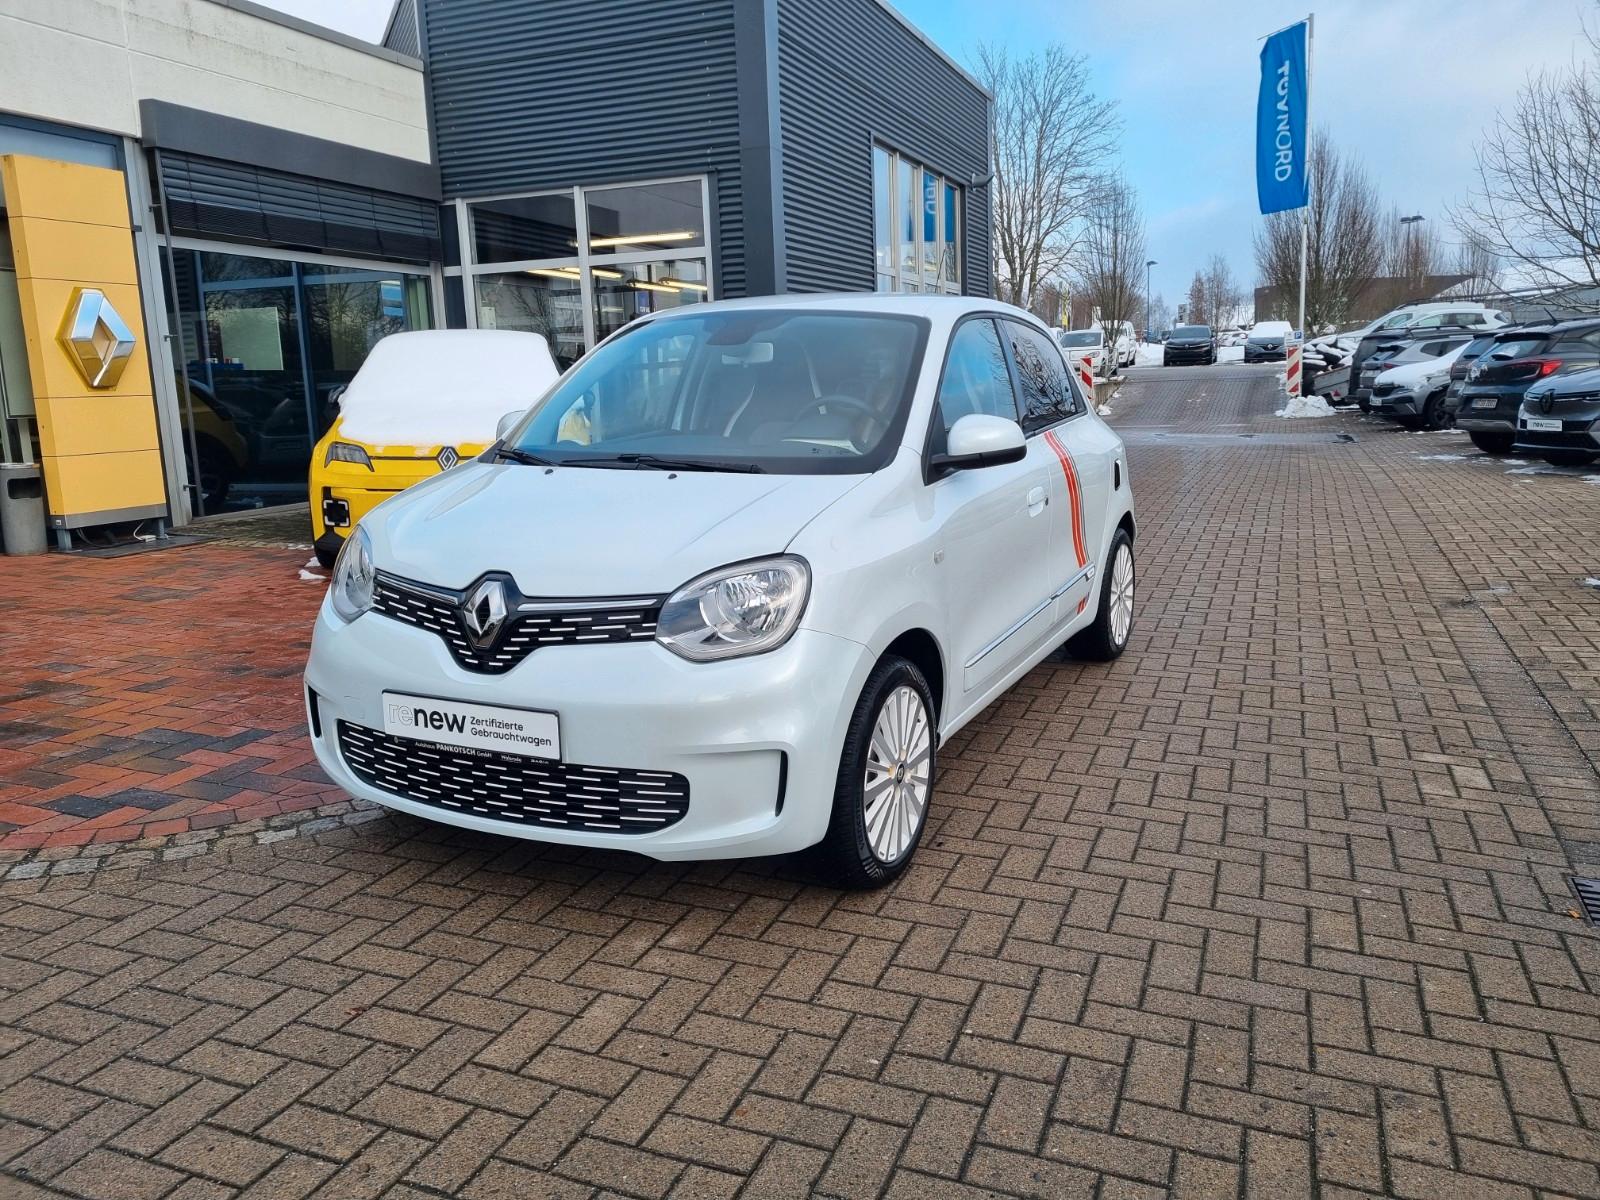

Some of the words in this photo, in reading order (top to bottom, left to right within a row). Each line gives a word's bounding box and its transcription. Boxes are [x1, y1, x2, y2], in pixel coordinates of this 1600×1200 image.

[388, 703, 466, 733] renew
[470, 716, 523, 731] Zertifizierte
[471, 727, 552, 746] Gebrauchtwagen
[436, 744, 476, 755] PANKOTSCH
